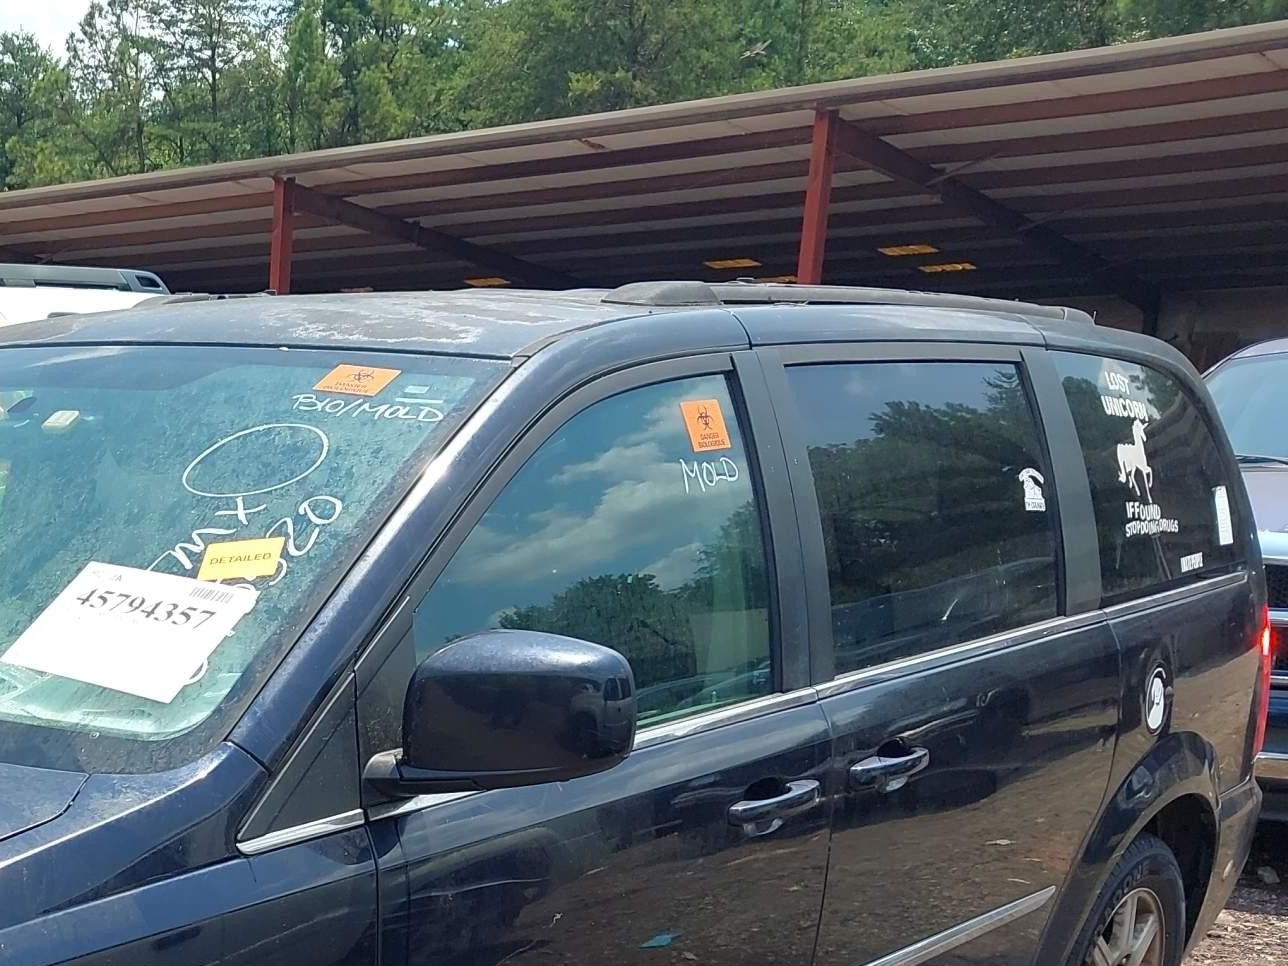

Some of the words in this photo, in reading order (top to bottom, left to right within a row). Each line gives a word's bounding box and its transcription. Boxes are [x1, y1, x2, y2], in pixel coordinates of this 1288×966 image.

[1104, 370, 1130, 395] LOST
[292, 394, 444, 422] BIO/MOLD
[1100, 395, 1149, 421] UNICORN
[679, 456, 739, 495] MOLD
[1125, 501, 1134, 519] IF
[1134, 501, 1162, 521] FOUND
[209, 552, 272, 566] DETAILED
[76, 587, 217, 630] 45794357
